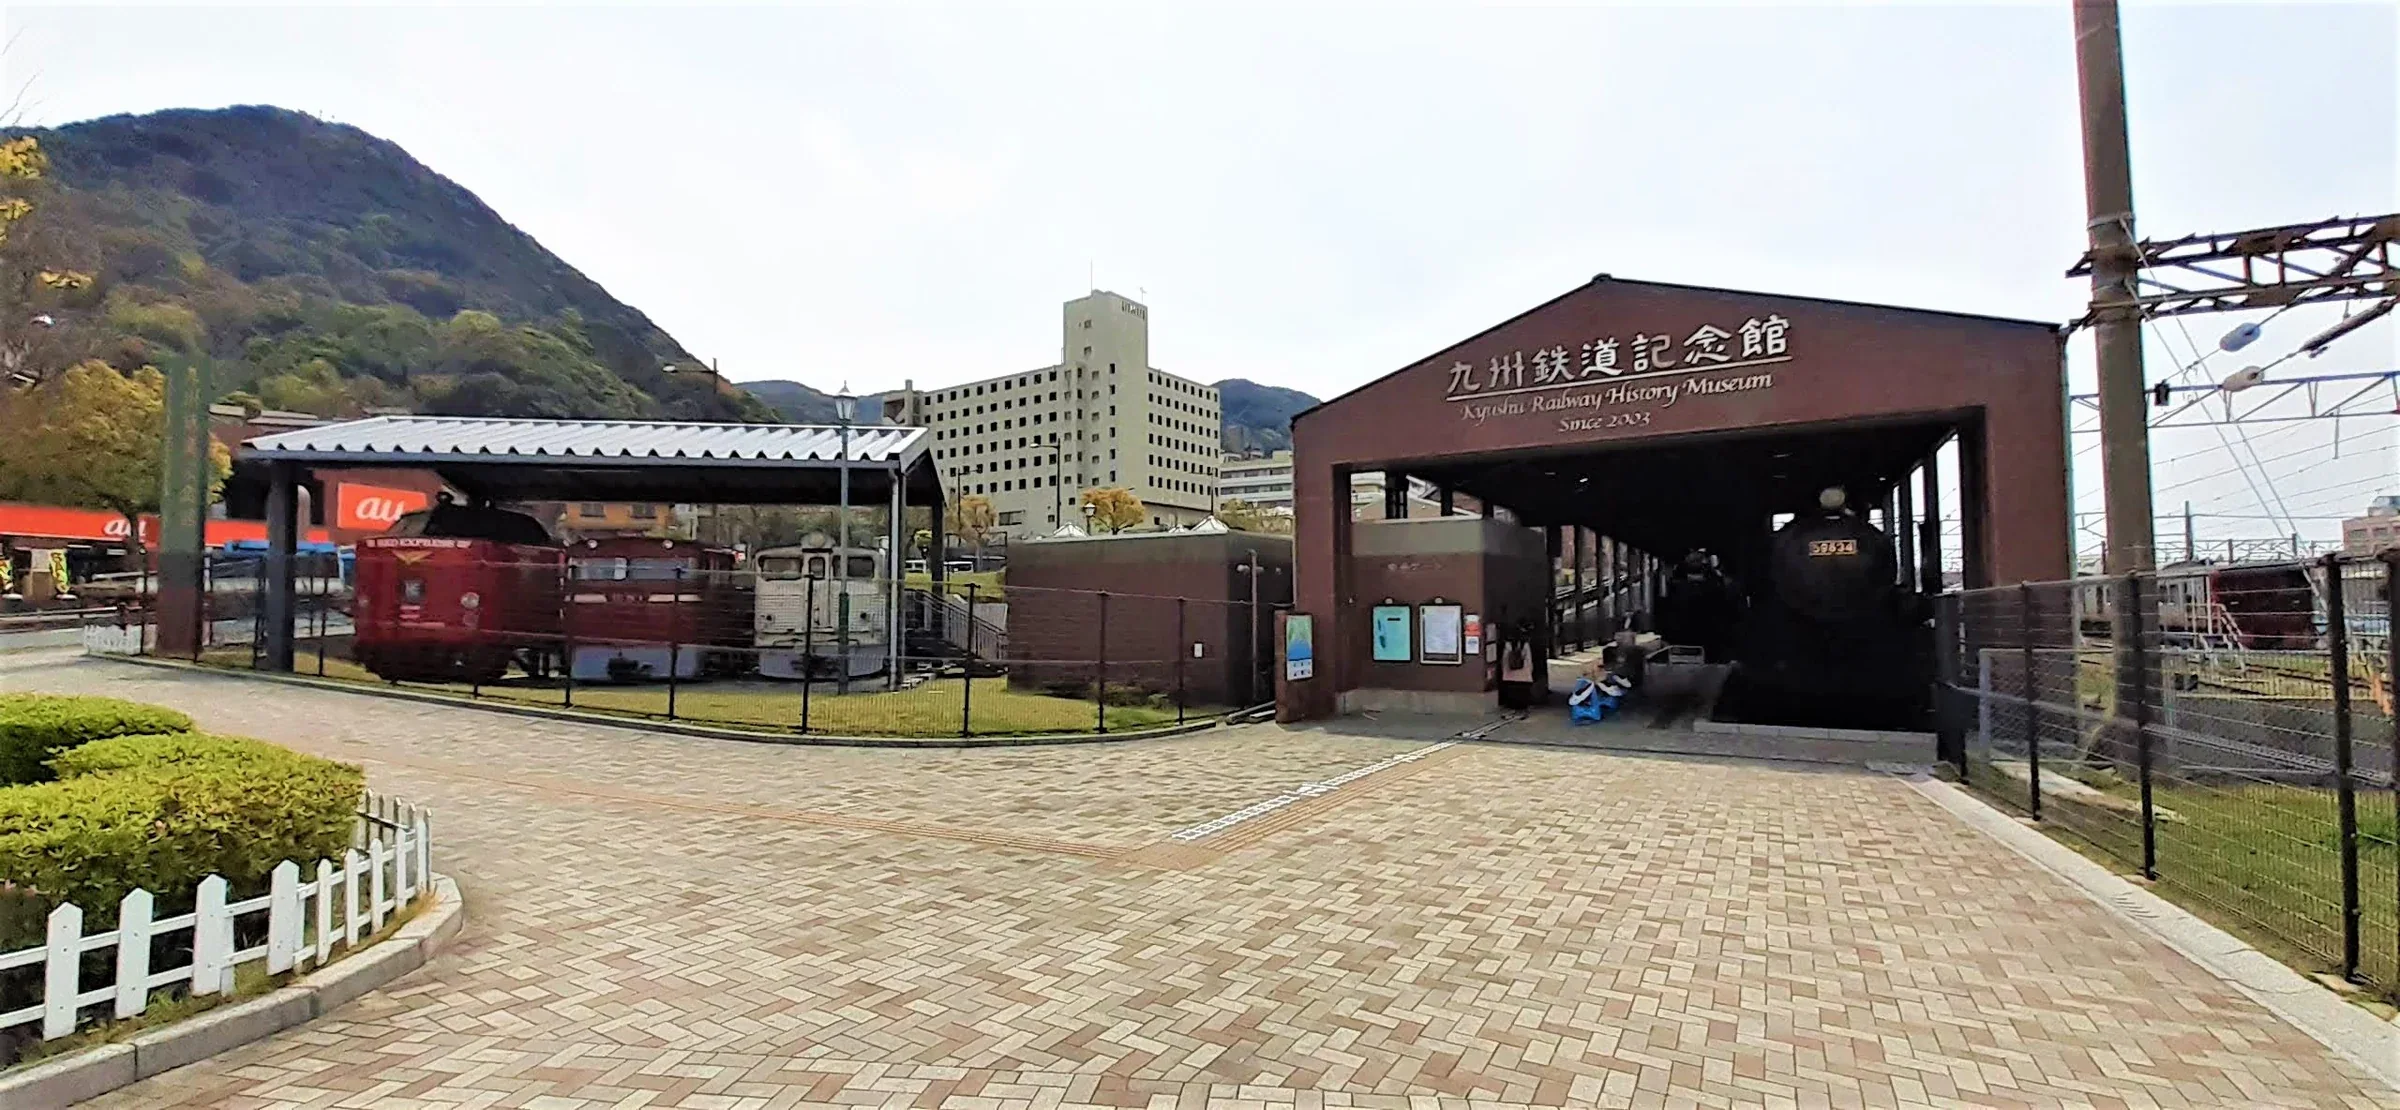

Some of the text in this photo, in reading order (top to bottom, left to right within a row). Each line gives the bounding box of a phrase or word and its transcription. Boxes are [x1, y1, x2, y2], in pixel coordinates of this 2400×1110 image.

[1447, 314, 1790, 393] 九州鉄道記念館
[1461, 373, 1773, 427] Kyushu Railway History Museum
[1559, 411, 1650, 432] Since 2003
[355, 497, 405, 521] au
